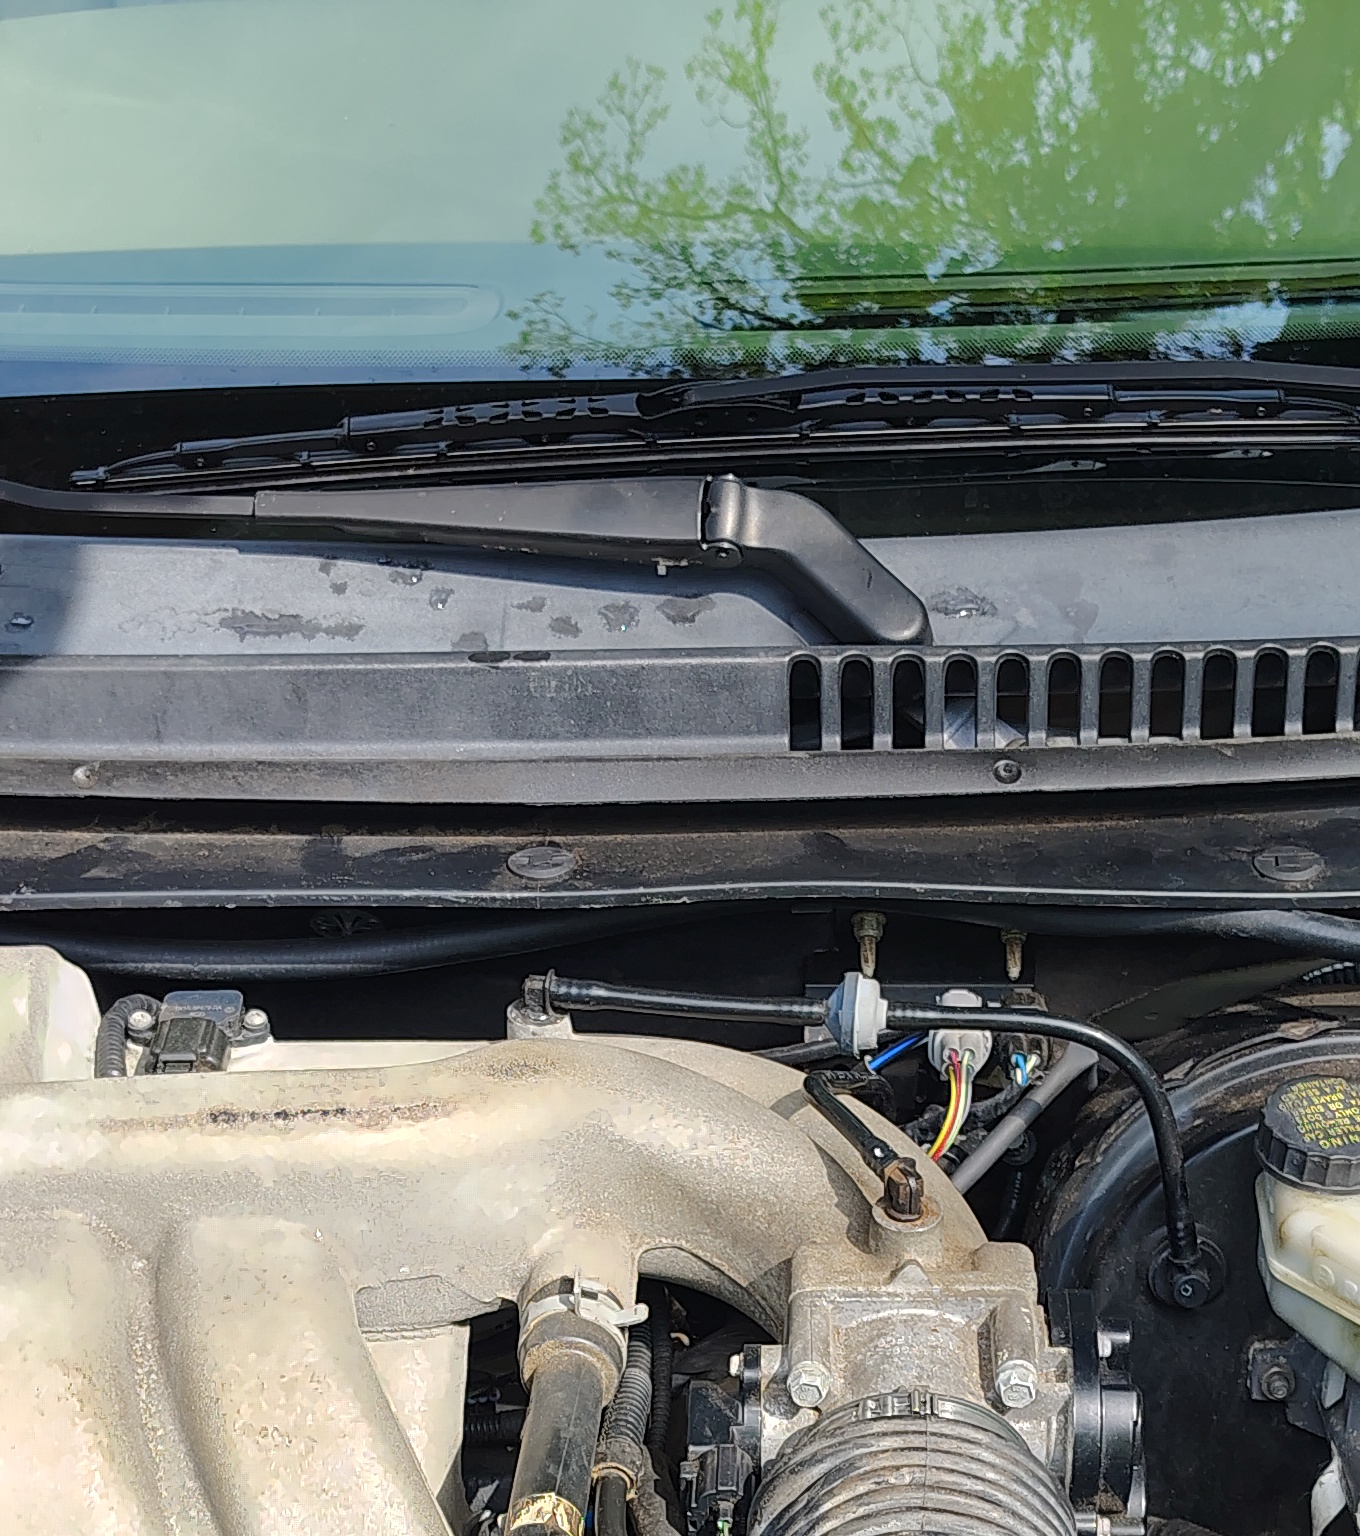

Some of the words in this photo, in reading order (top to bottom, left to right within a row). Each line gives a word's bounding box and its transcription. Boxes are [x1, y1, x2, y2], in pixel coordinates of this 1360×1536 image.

[1311, 1092, 1345, 1105] BRAKE
[1334, 1107, 1360, 1118] ONLY
[1327, 1124, 1360, 1136] FILLER
